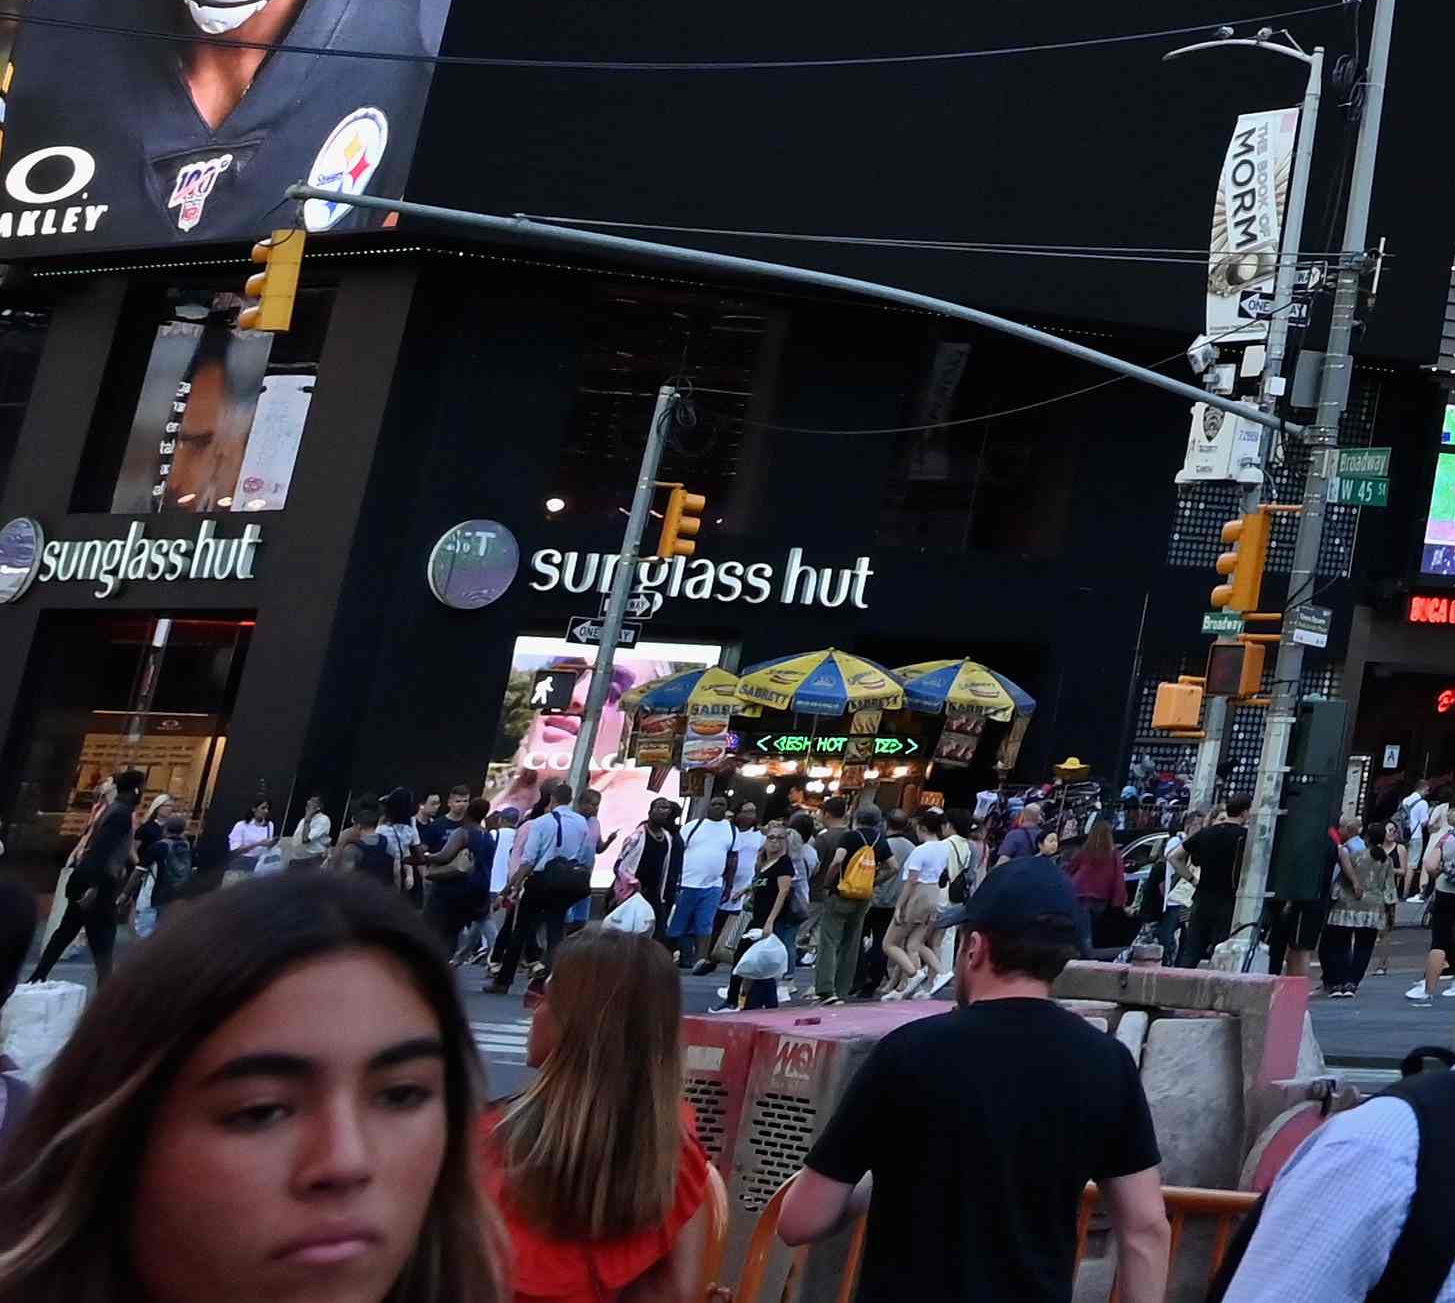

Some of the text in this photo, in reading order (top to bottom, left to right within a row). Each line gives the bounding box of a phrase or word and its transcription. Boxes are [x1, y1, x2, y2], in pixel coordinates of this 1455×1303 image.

[1256, 121, 1269, 156] THE
[1256, 161, 1269, 209] BOOK
[1248, 298, 1304, 317] ONE AY
[1339, 452, 1388, 473] Broadway
[1341, 480, 1354, 500] W
[1358, 481, 1373, 501] 45
[39, 519, 262, 598] sunglass hut
[780, 547, 874, 609] hut
[579, 625, 600, 639] ONE
[1203, 615, 1244, 633] Broadway
[739, 684, 788, 705] SABRETT
[815, 737, 848, 752] HOT
